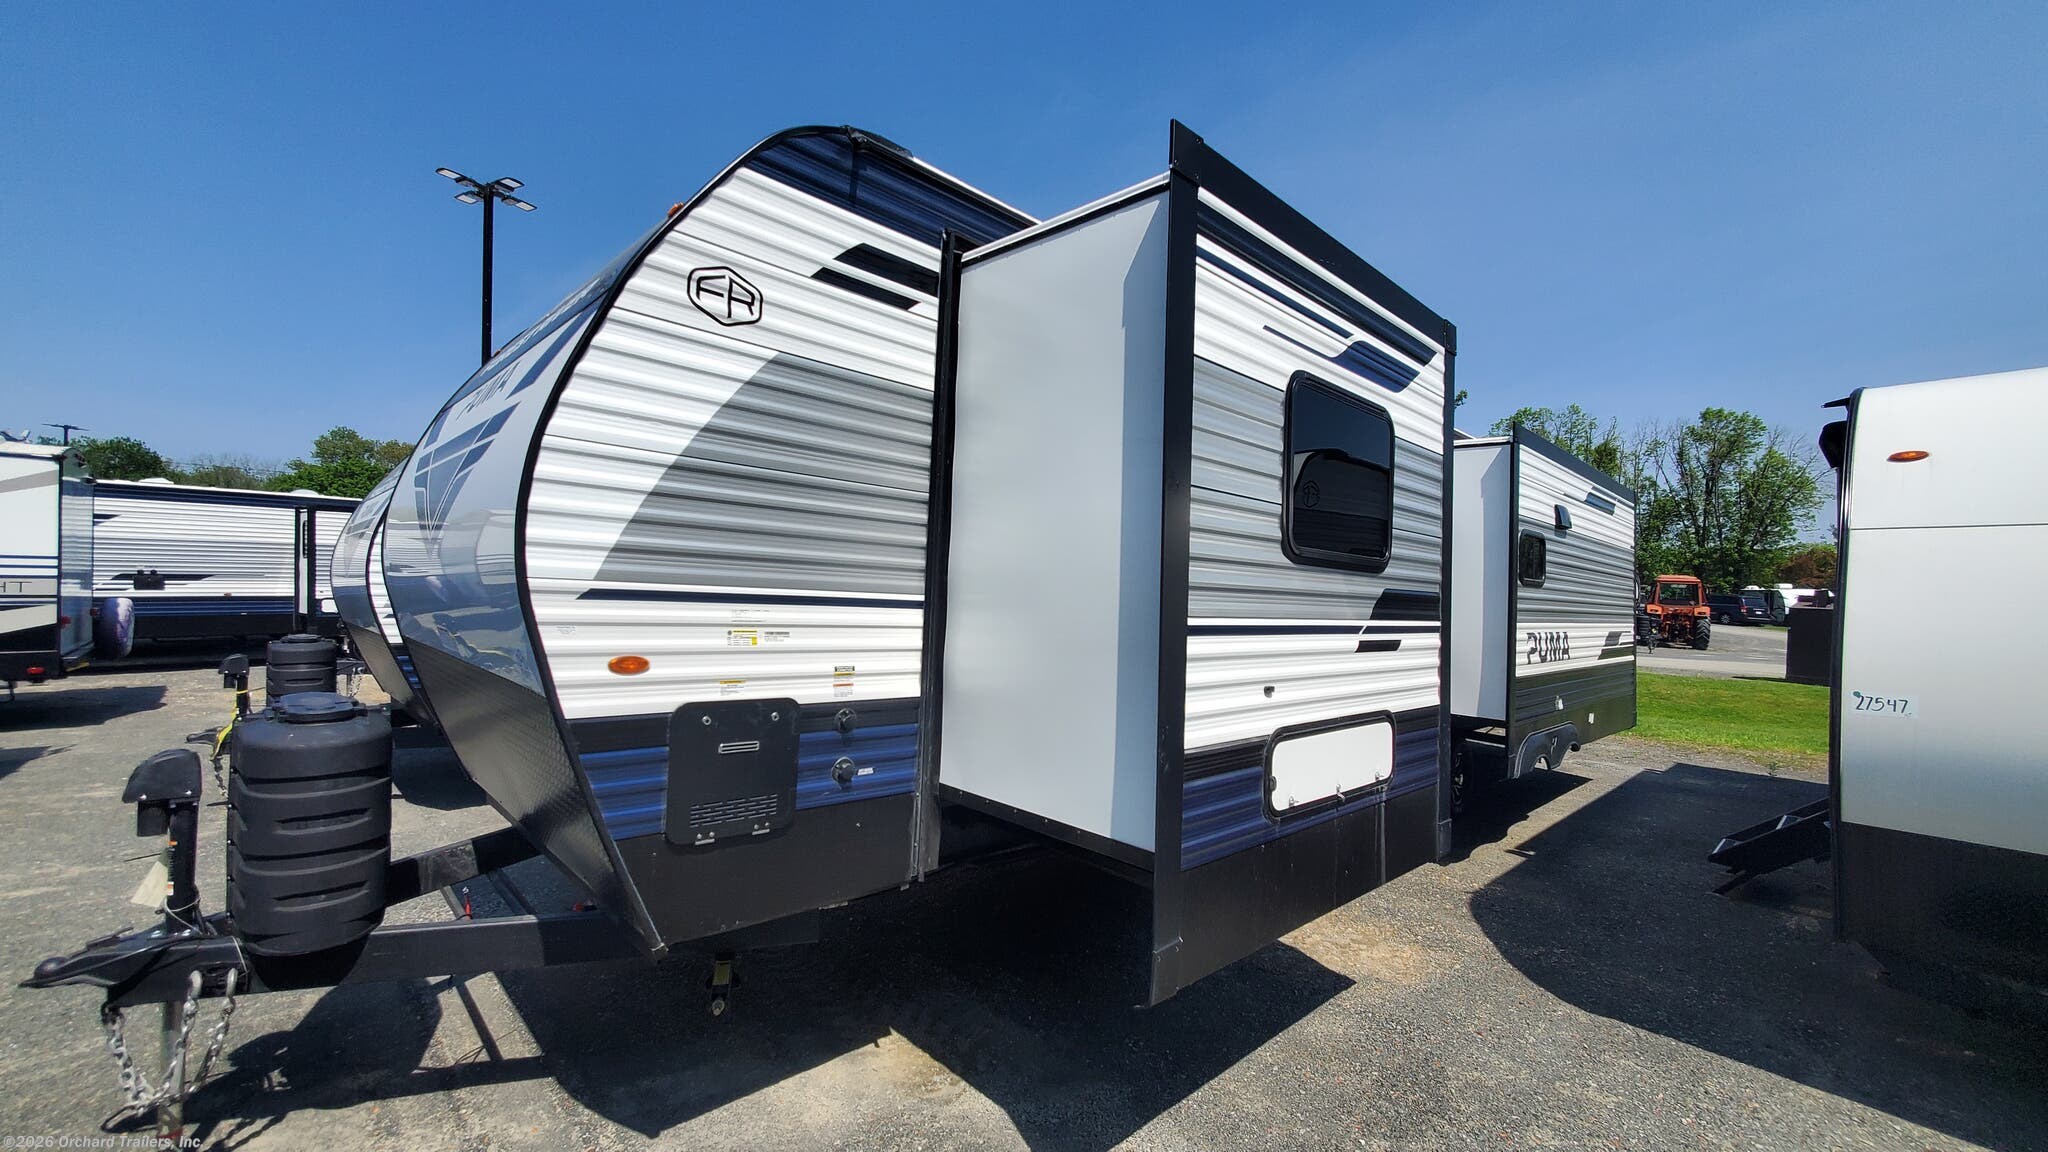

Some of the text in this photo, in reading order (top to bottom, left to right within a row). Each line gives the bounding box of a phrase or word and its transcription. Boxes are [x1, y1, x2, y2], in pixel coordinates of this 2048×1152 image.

[696, 275, 756, 318] FR
[1527, 632, 1570, 664] PUMA
[1856, 695, 1909, 713] 27547
